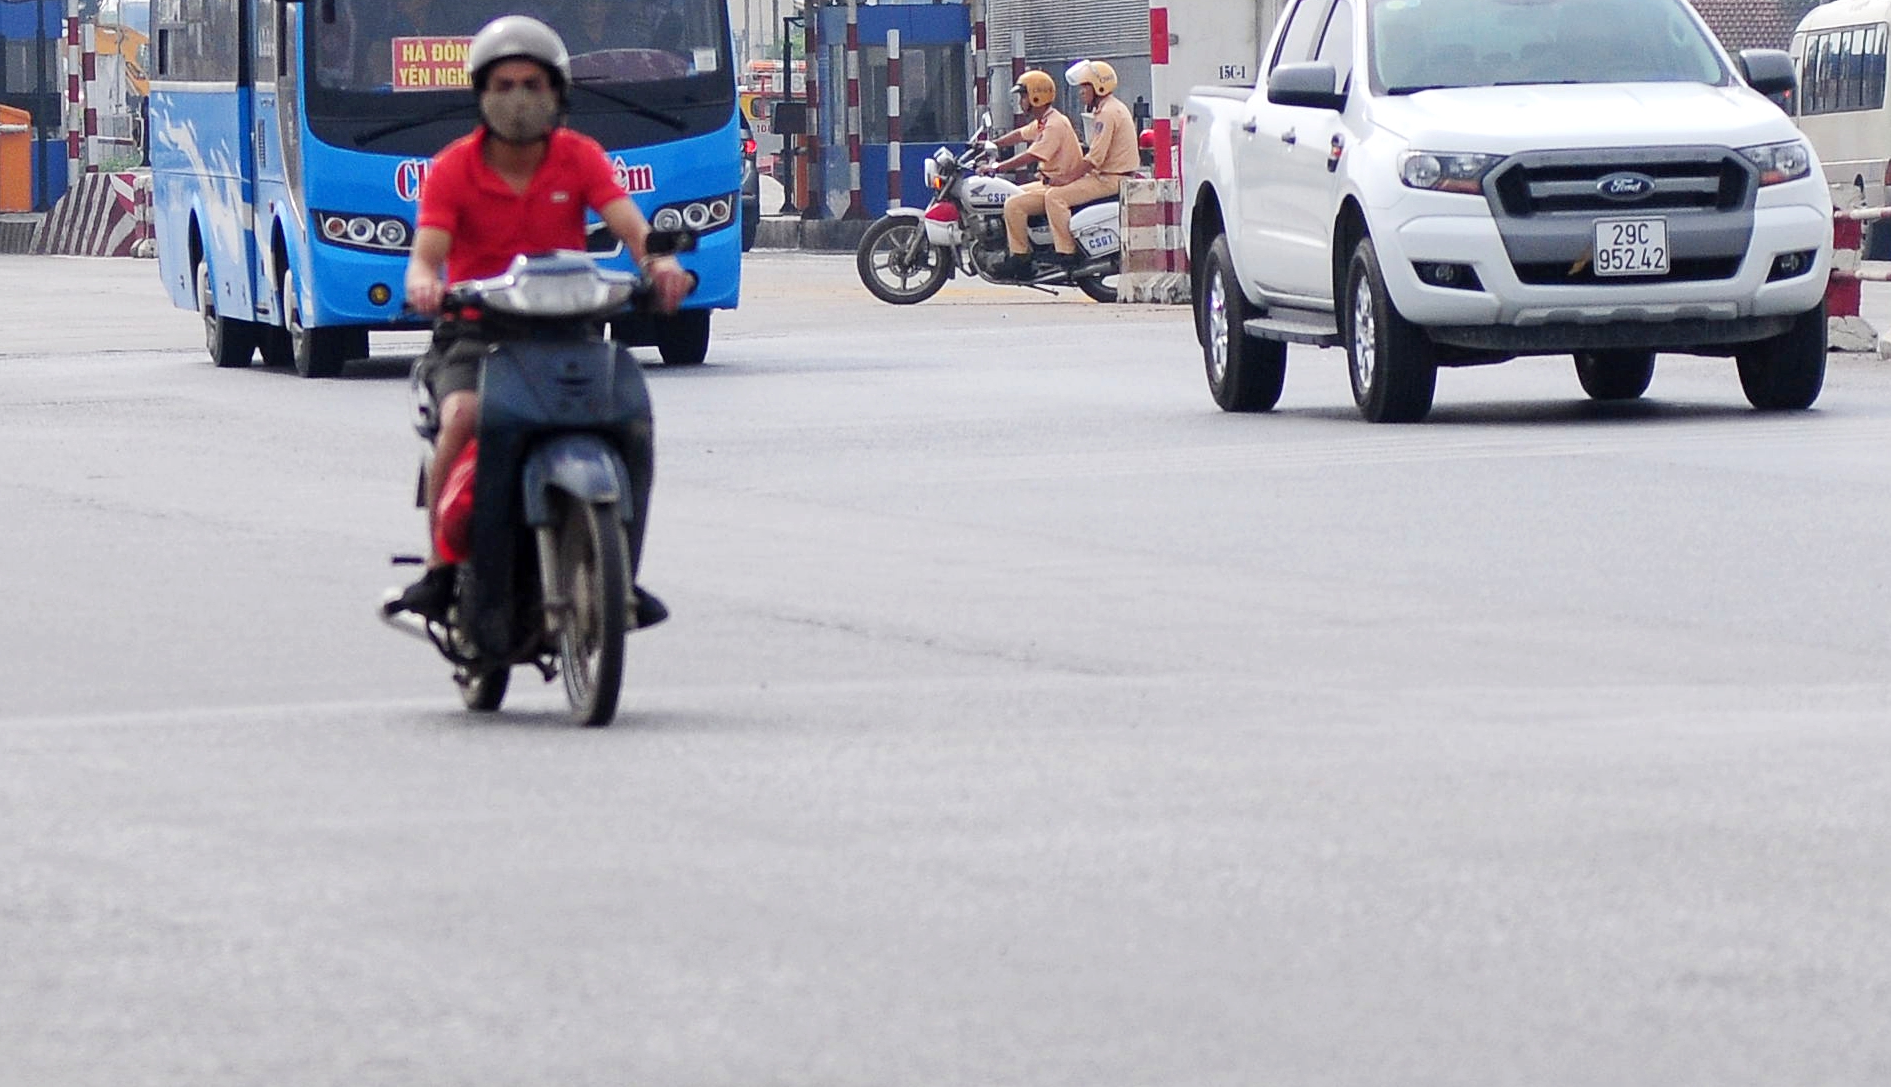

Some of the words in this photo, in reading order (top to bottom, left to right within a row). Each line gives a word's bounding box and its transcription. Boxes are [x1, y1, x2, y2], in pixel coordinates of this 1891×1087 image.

[402, 40, 427, 62] HÀ
[432, 40, 471, 62] ĐÔN
[399, 64, 430, 86] YÊN
[1610, 178, 1641, 193] Ford
[1612, 223, 1649, 245] 29C
[1599, 248, 1665, 270] 952.42
